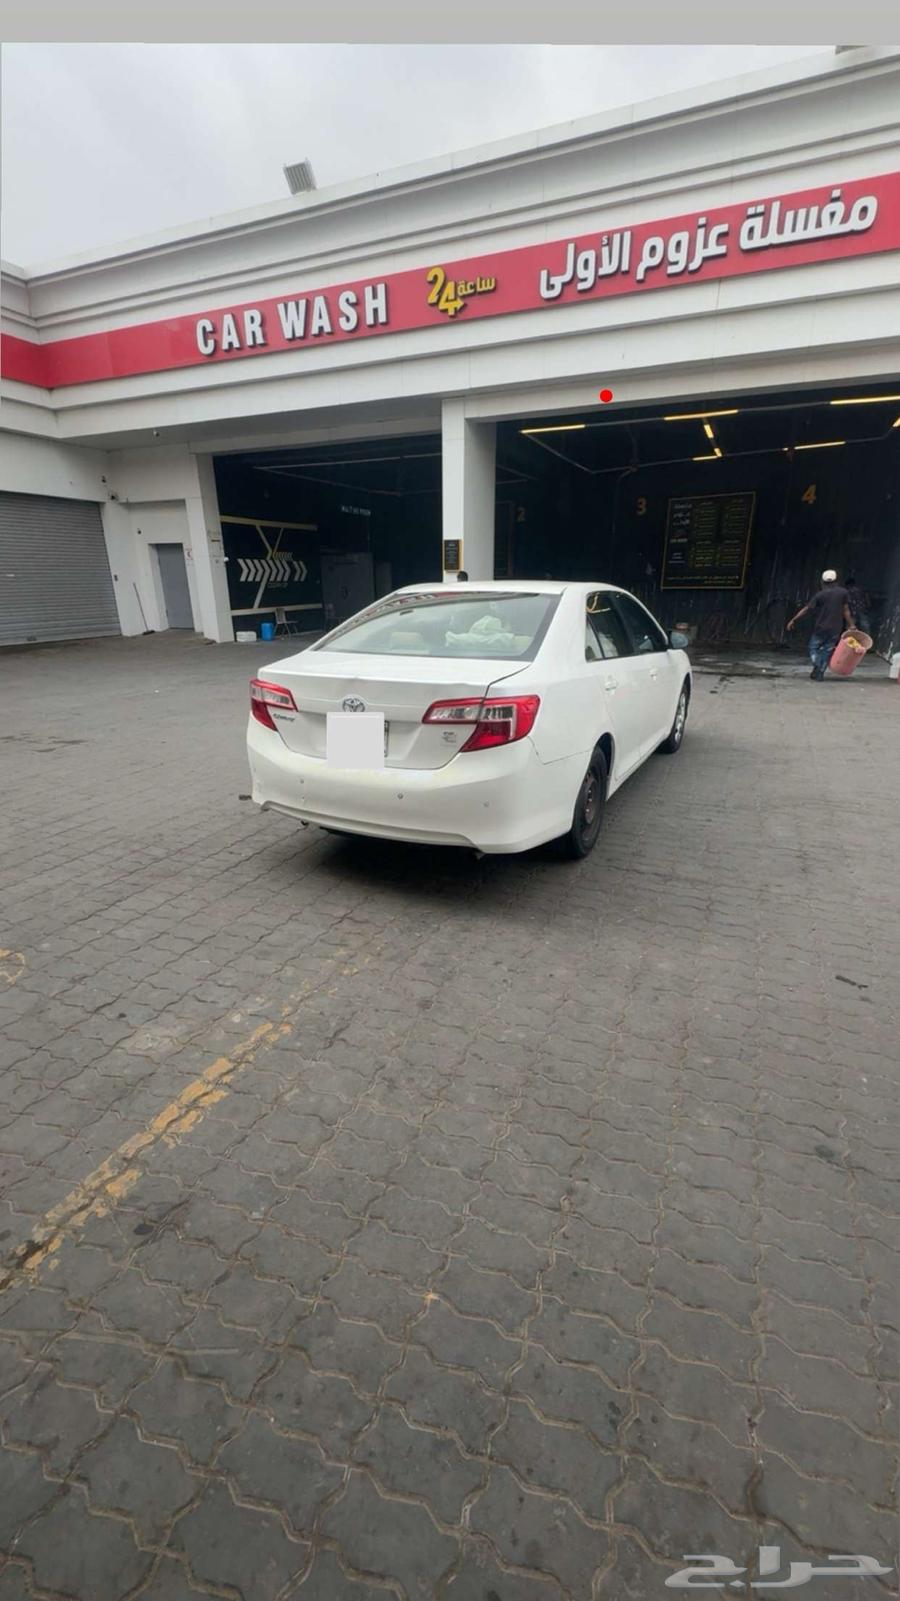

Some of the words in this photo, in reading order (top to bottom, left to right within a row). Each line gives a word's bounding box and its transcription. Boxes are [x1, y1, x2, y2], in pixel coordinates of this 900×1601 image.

[636, 217, 729, 281] عزوم
[739, 189, 879, 250] مغسلة
[427, 266, 465, 316] 24
[457, 276, 497, 297] ساعة
[539, 230, 632, 299] الأولى
[196, 309, 267, 356] CAR
[276, 282, 388, 340] WASH
[637, 497, 647, 515] 3
[801, 484, 817, 504] 4
